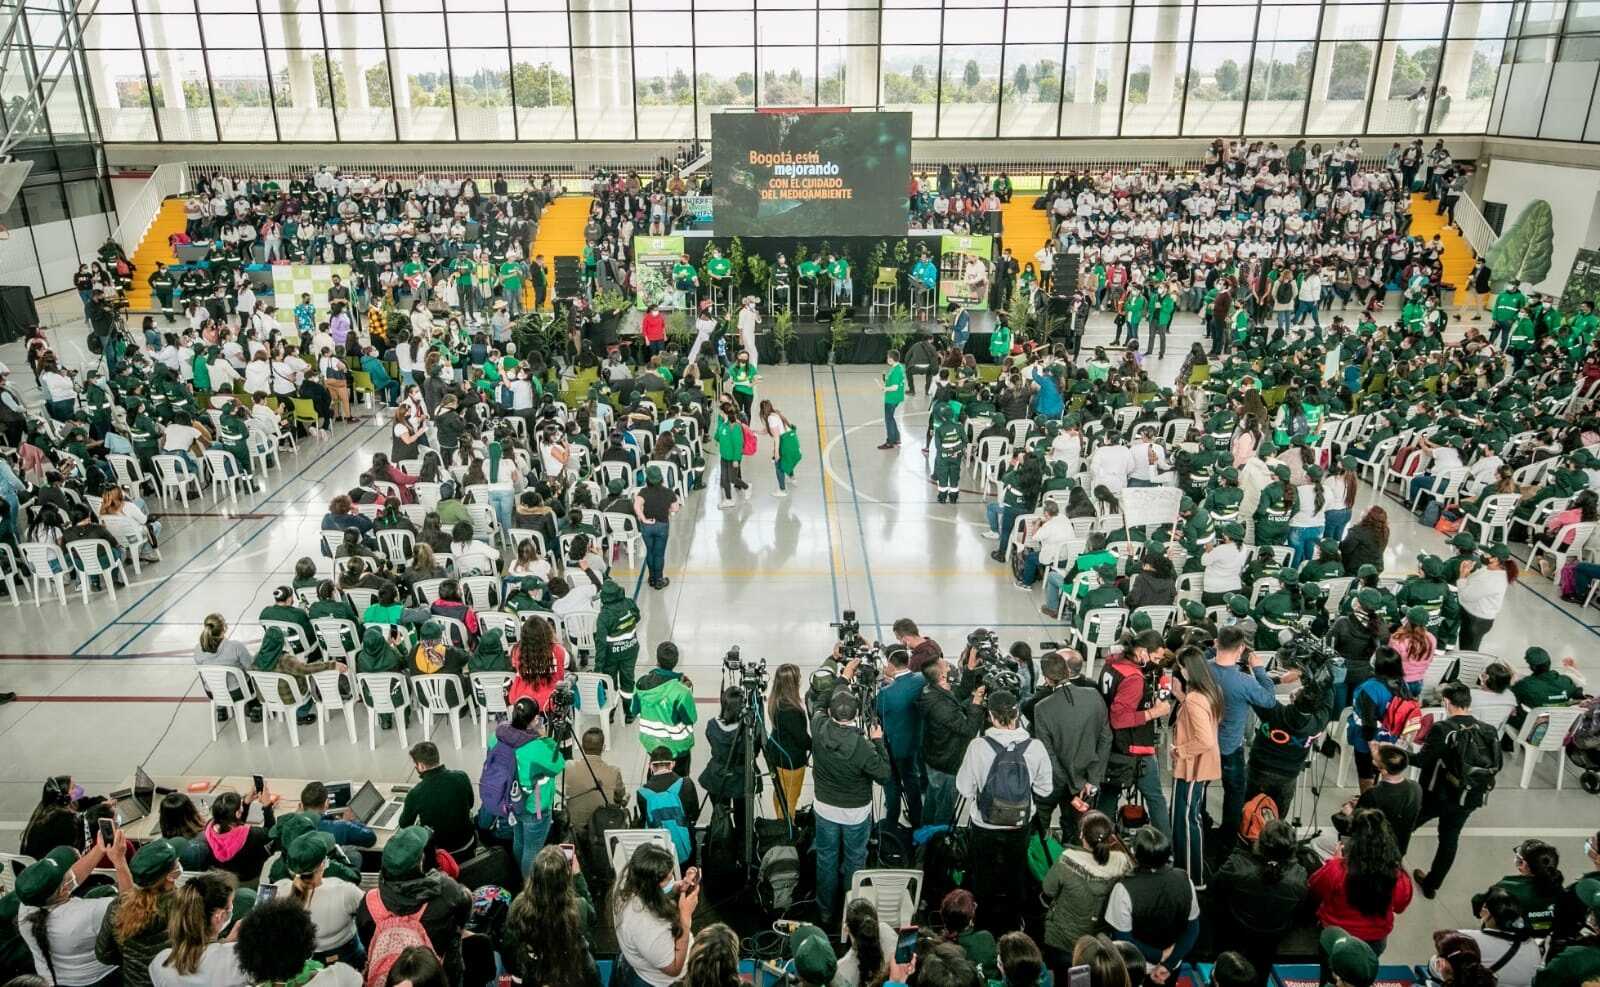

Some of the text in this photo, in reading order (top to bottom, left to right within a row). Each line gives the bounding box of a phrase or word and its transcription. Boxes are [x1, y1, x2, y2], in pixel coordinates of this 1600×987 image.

[749, 150, 819, 167] Bogotá está
[774, 161, 839, 178] mejorando
[769, 178, 843, 188] CON EL CUIDADO
[761, 188, 853, 199] DEL MEDIOAMBIENTE
